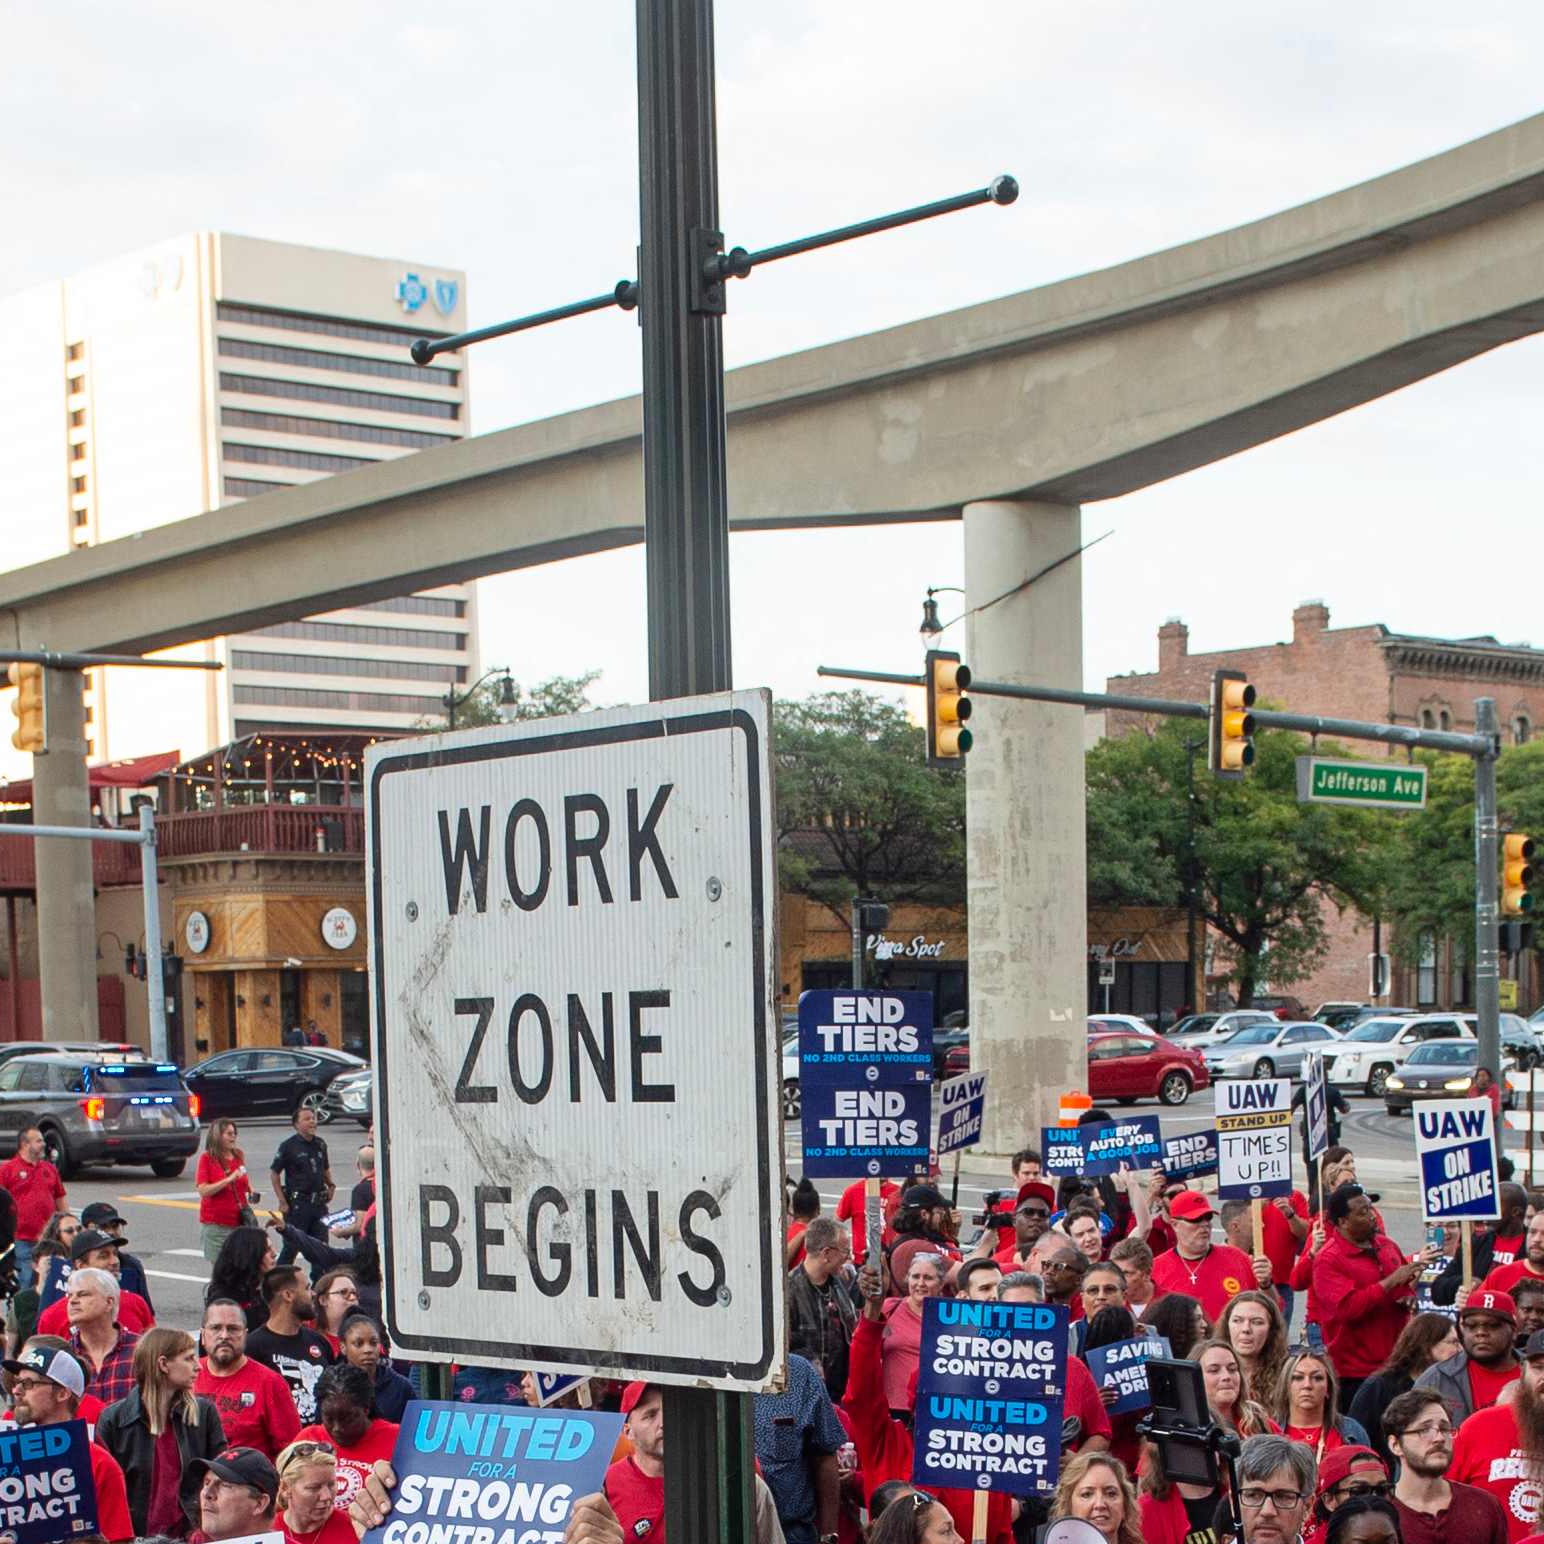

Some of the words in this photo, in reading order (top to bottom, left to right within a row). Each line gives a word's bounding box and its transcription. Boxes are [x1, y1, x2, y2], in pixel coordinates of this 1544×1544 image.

[1317, 770, 1387, 793] Jefferson
[1392, 775, 1420, 796] Ave
[437, 783, 679, 916] WORK
[906, 936, 945, 958] Spot
[834, 997, 904, 1024] END
[454, 989, 676, 1103] ZONE
[817, 1026, 919, 1053] TIERS
[804, 1054, 821, 1064] NO
[823, 1054, 845, 1064] 2ND
[848, 1054, 880, 1064] CLASS
[883, 1053, 931, 1064] WORKERS
[835, 1091, 905, 1117] END
[943, 1077, 986, 1105] UAW
[1228, 1083, 1278, 1109] UAW
[953, 1109, 970, 1128] ON
[1100, 1123, 1141, 1139] EVERY
[1220, 1115, 1263, 1129] STAND
[1265, 1114, 1287, 1126] UP
[1418, 1110, 1485, 1139] UAW
[820, 1120, 918, 1147] TIERS
[940, 1115, 981, 1151] STRIKE
[1089, 1136, 1125, 1152] AUTO
[1127, 1133, 1154, 1147] JOB
[1162, 1146, 1218, 1172] TIERS
[1166, 1136, 1208, 1157] END
[1222, 1135, 1287, 1158] TIME'S
[1237, 1158, 1282, 1180] UP!!
[1444, 1148, 1471, 1181] ON
[1427, 1170, 1493, 1214] STRIKE
[418, 1184, 731, 1308] BEGINS
[938, 1303, 1055, 1330] UNITED
[936, 1335, 1054, 1361] STRONG
[1106, 1342, 1163, 1364] SAVING
[933, 1358, 1056, 1381] CONTRACT
[930, 1397, 1047, 1425] UNITED
[414, 1410, 595, 1461] UNITED
[927, 1429, 1046, 1456] STRONG
[467, 1462, 500, 1478] FOR
[503, 1464, 518, 1478] A
[925, 1452, 1047, 1475] CONTRACT
[394, 1475, 573, 1524] STRONG
